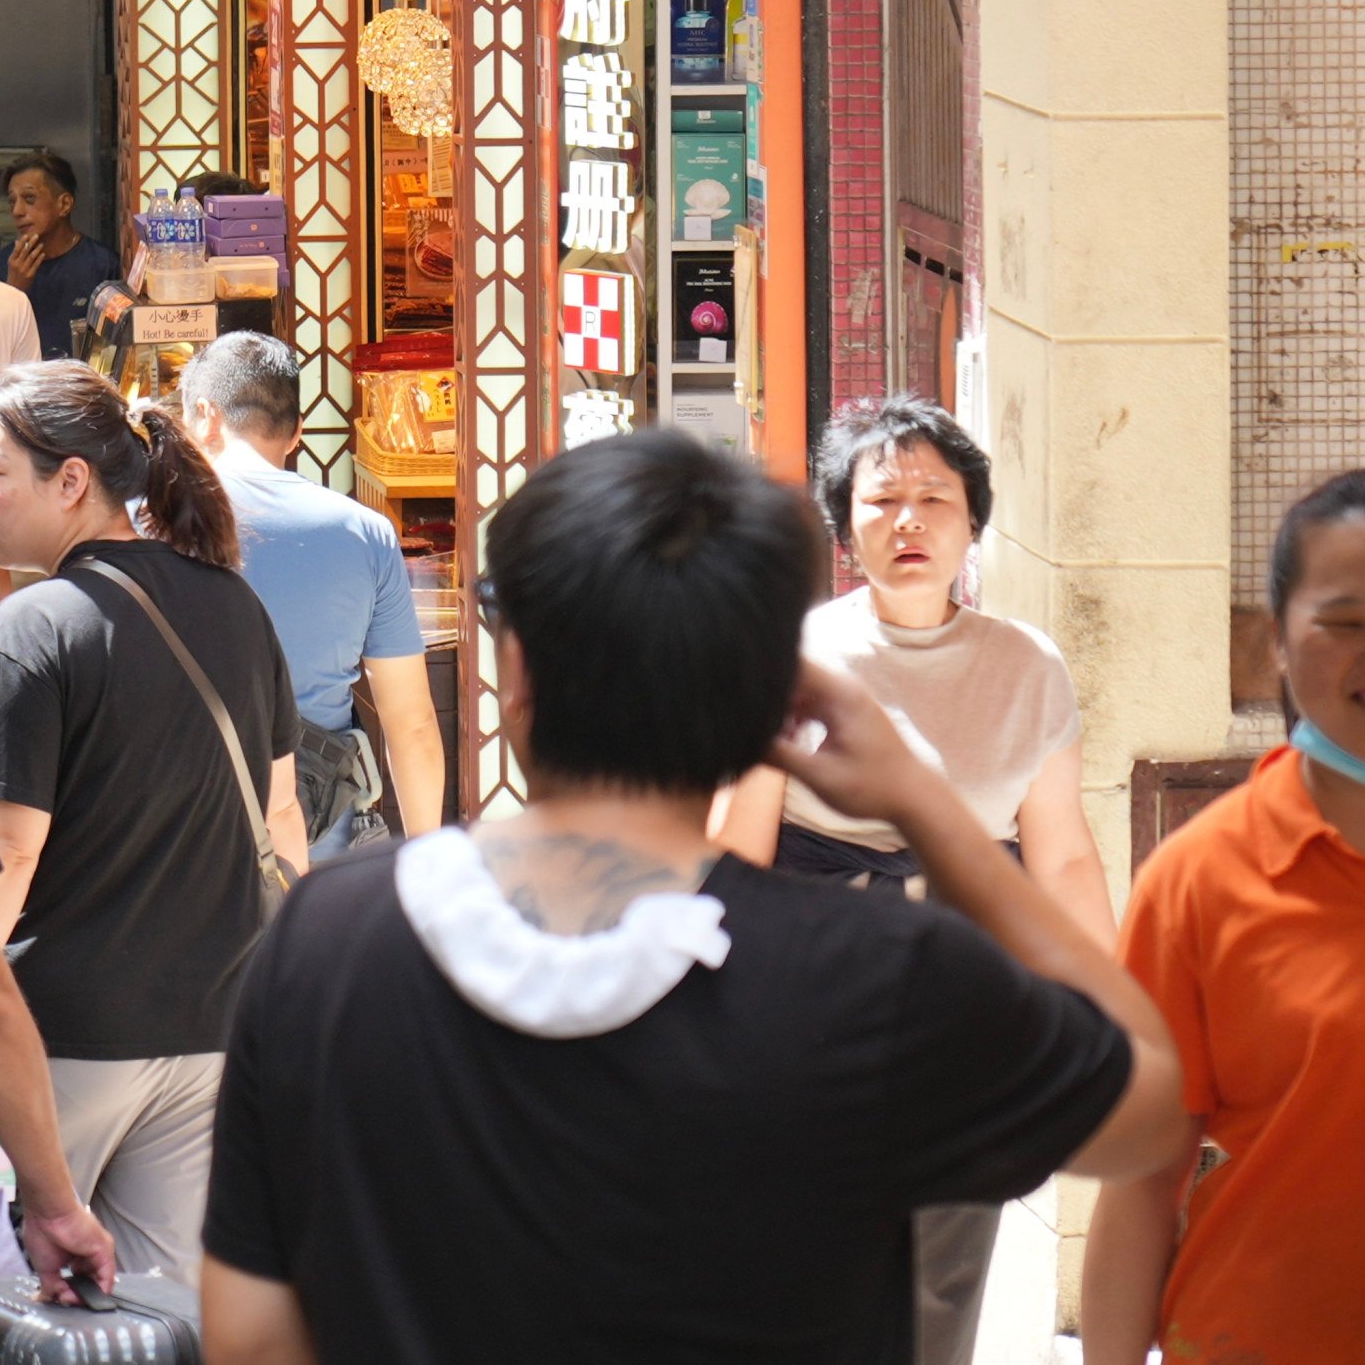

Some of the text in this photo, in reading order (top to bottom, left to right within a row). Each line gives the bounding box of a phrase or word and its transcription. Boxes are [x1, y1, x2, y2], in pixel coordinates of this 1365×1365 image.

[142, 328, 209, 339] Hot! Be careful!
